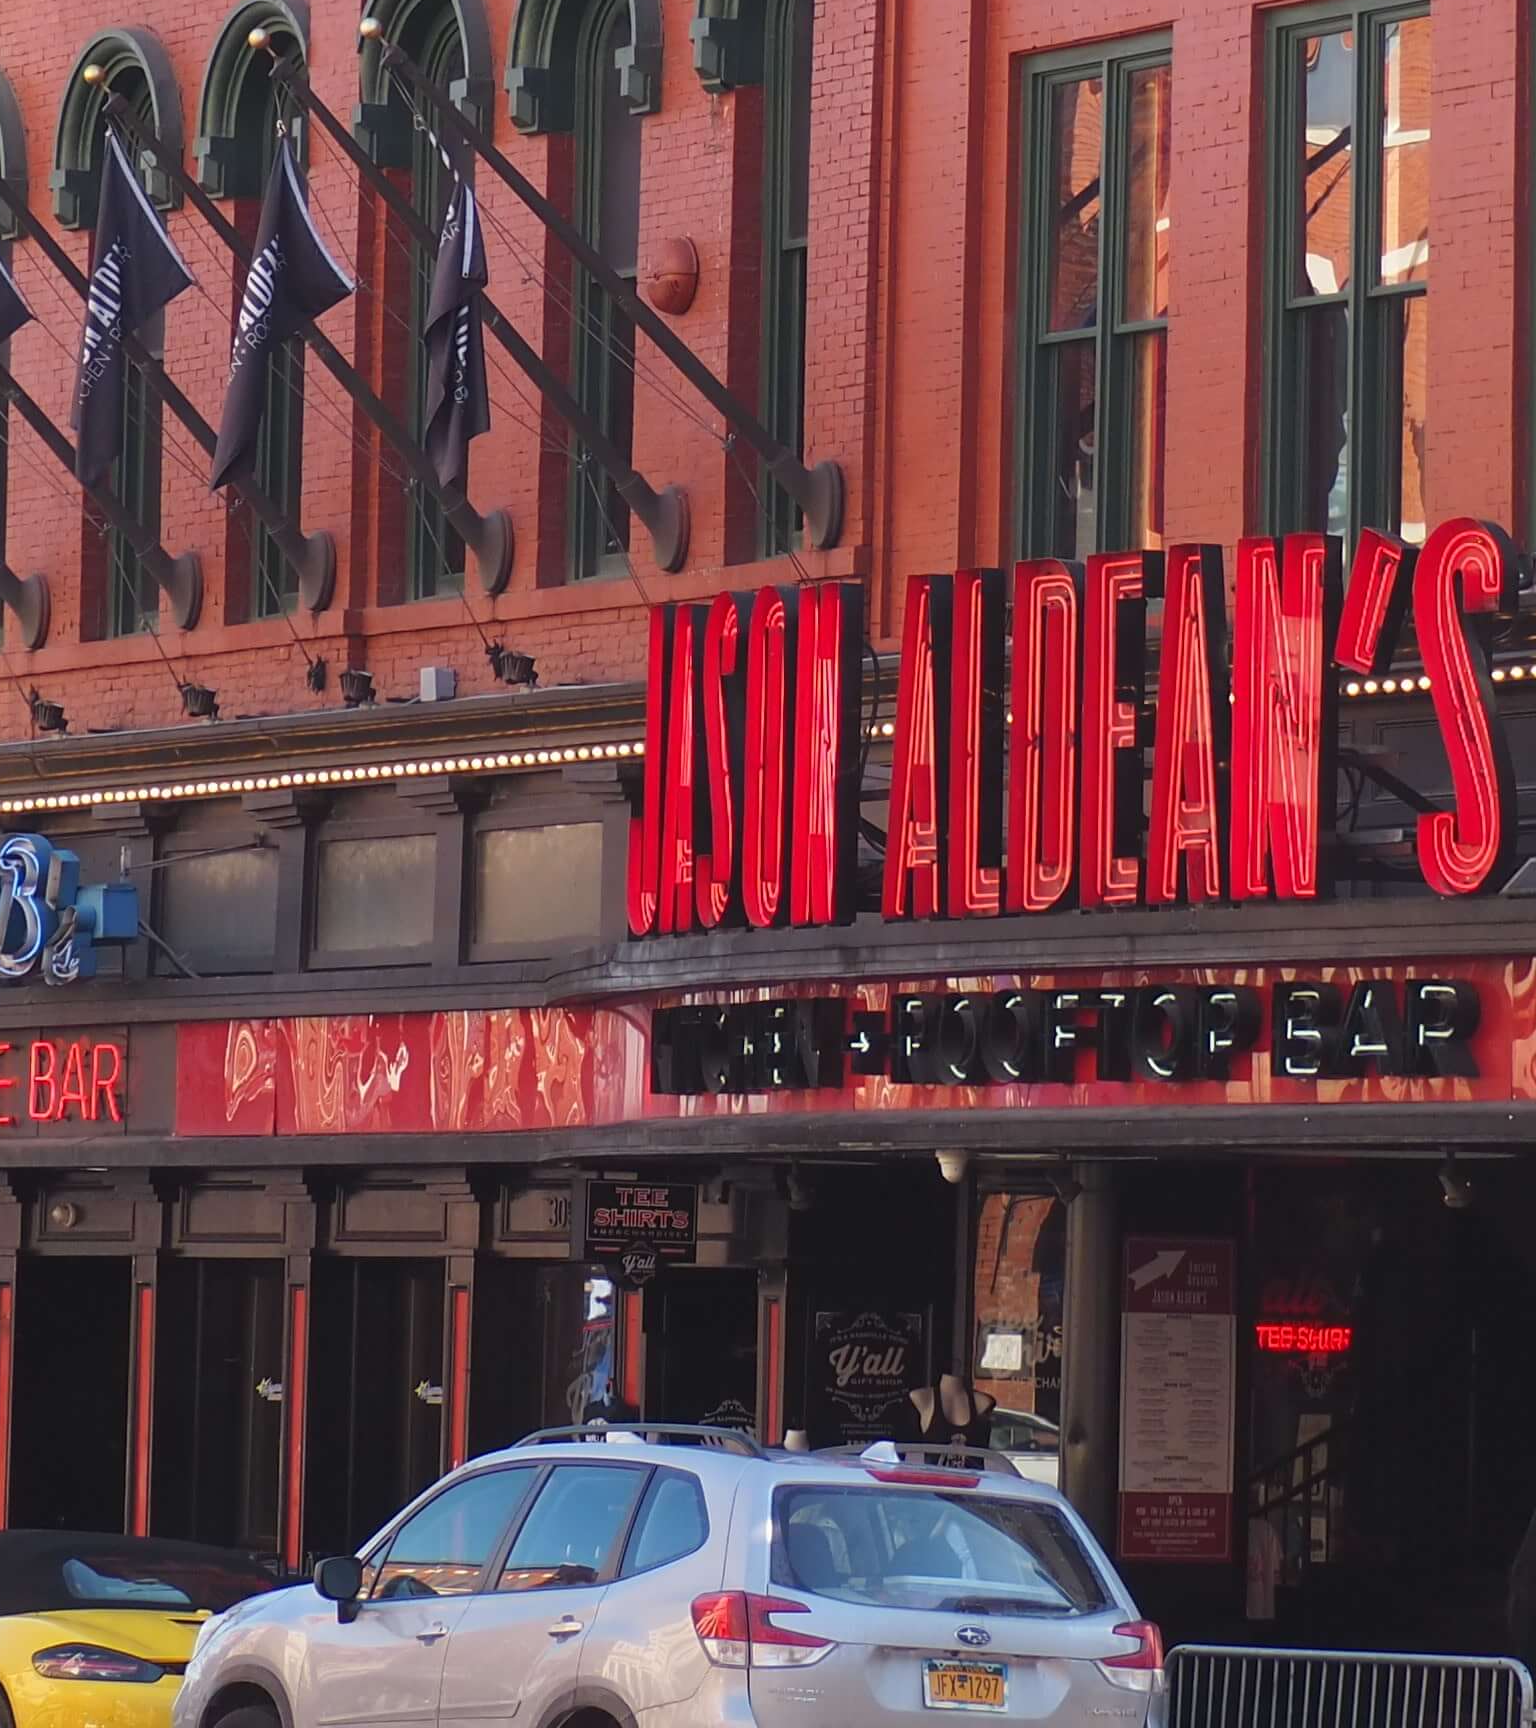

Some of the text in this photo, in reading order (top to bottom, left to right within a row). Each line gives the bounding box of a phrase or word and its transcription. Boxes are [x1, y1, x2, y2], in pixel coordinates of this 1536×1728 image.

[626, 517, 1520, 938] JASON ALDEAN'S
[891, 983, 1262, 1086] ROOFTOP
[1271, 978, 1481, 1081] BAR
[28, 1041, 123, 1123] BAR
[548, 1196, 572, 1228] 30
[615, 1187, 669, 1208] TEE
[593, 1207, 689, 1229] SHIRTS
[621, 1254, 656, 1277] Y'all
[828, 1343, 905, 1387] Y'all
[968, 1675, 1000, 1701] 1297
